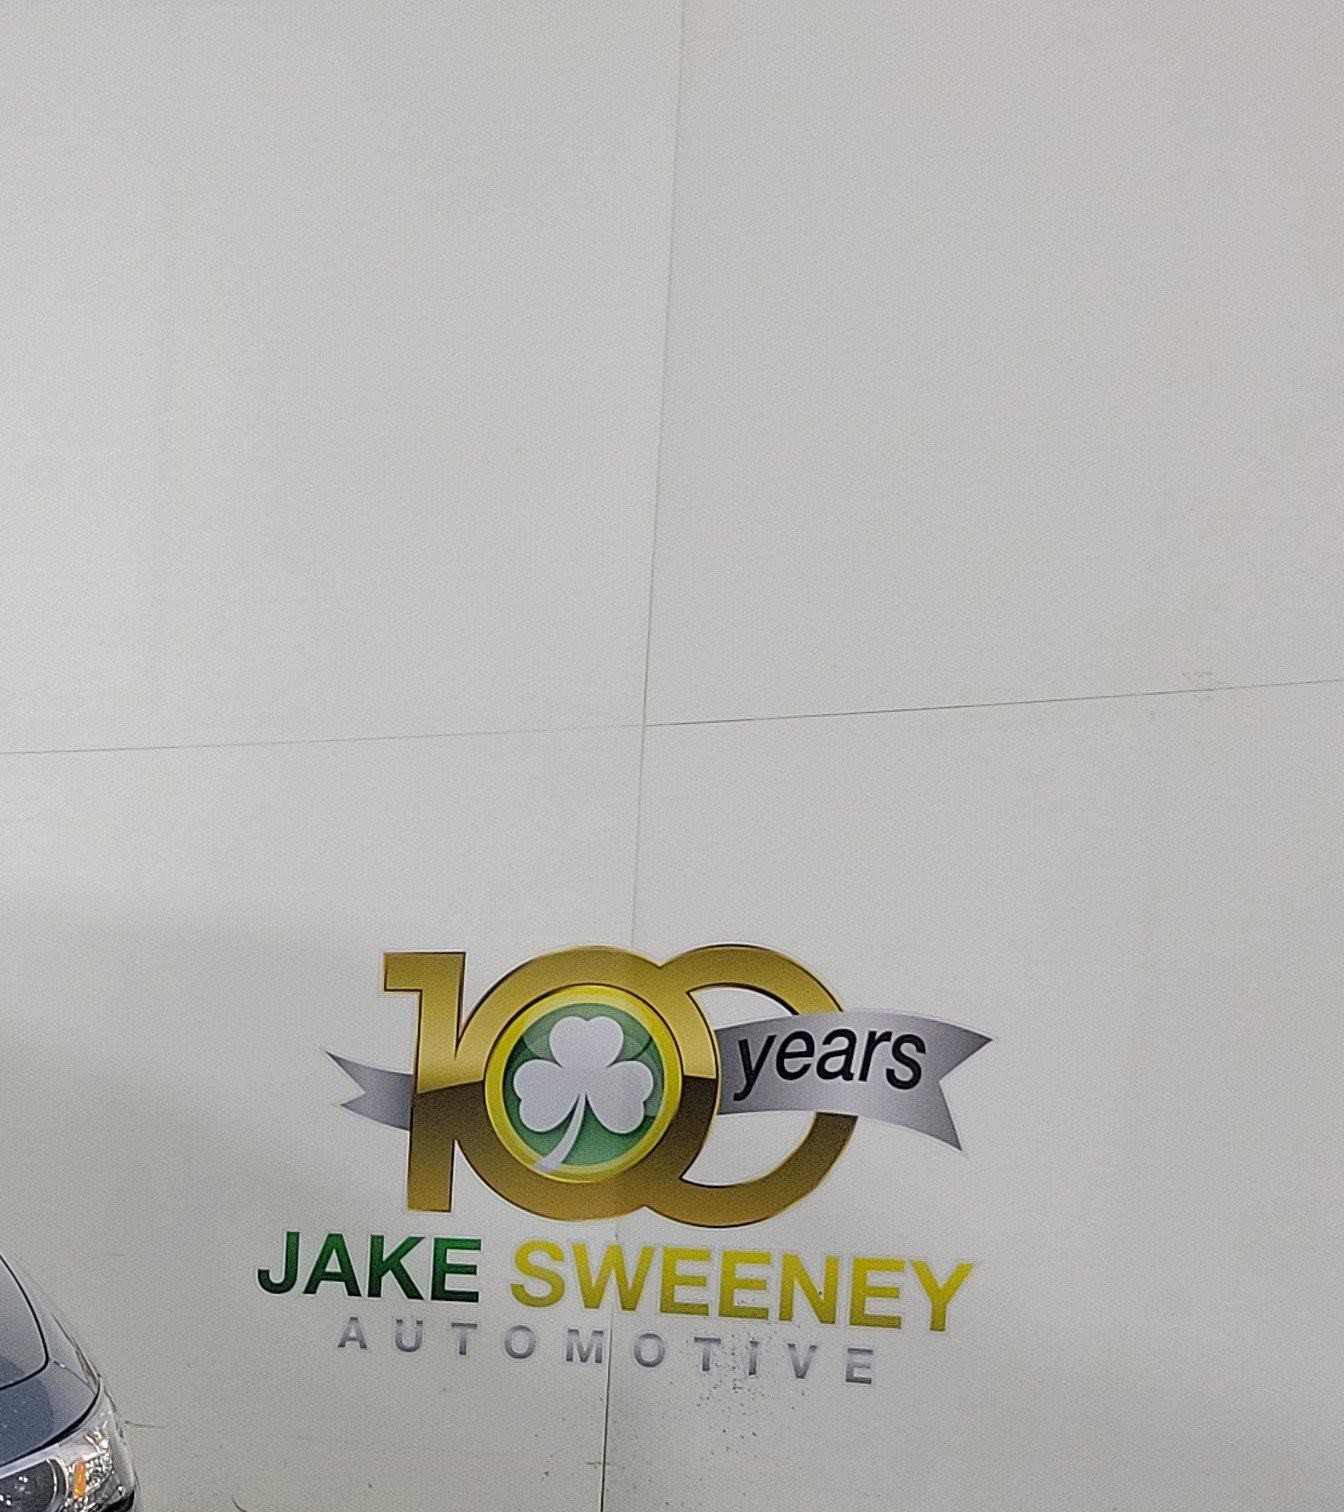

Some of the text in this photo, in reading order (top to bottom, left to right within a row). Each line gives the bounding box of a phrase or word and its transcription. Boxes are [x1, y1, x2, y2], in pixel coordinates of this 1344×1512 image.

[384, 944, 927, 1228] 100 years
[257, 1231, 975, 1332] JAKE SWEENEY
[337, 1316, 874, 1385] AUTOMOTIVE
